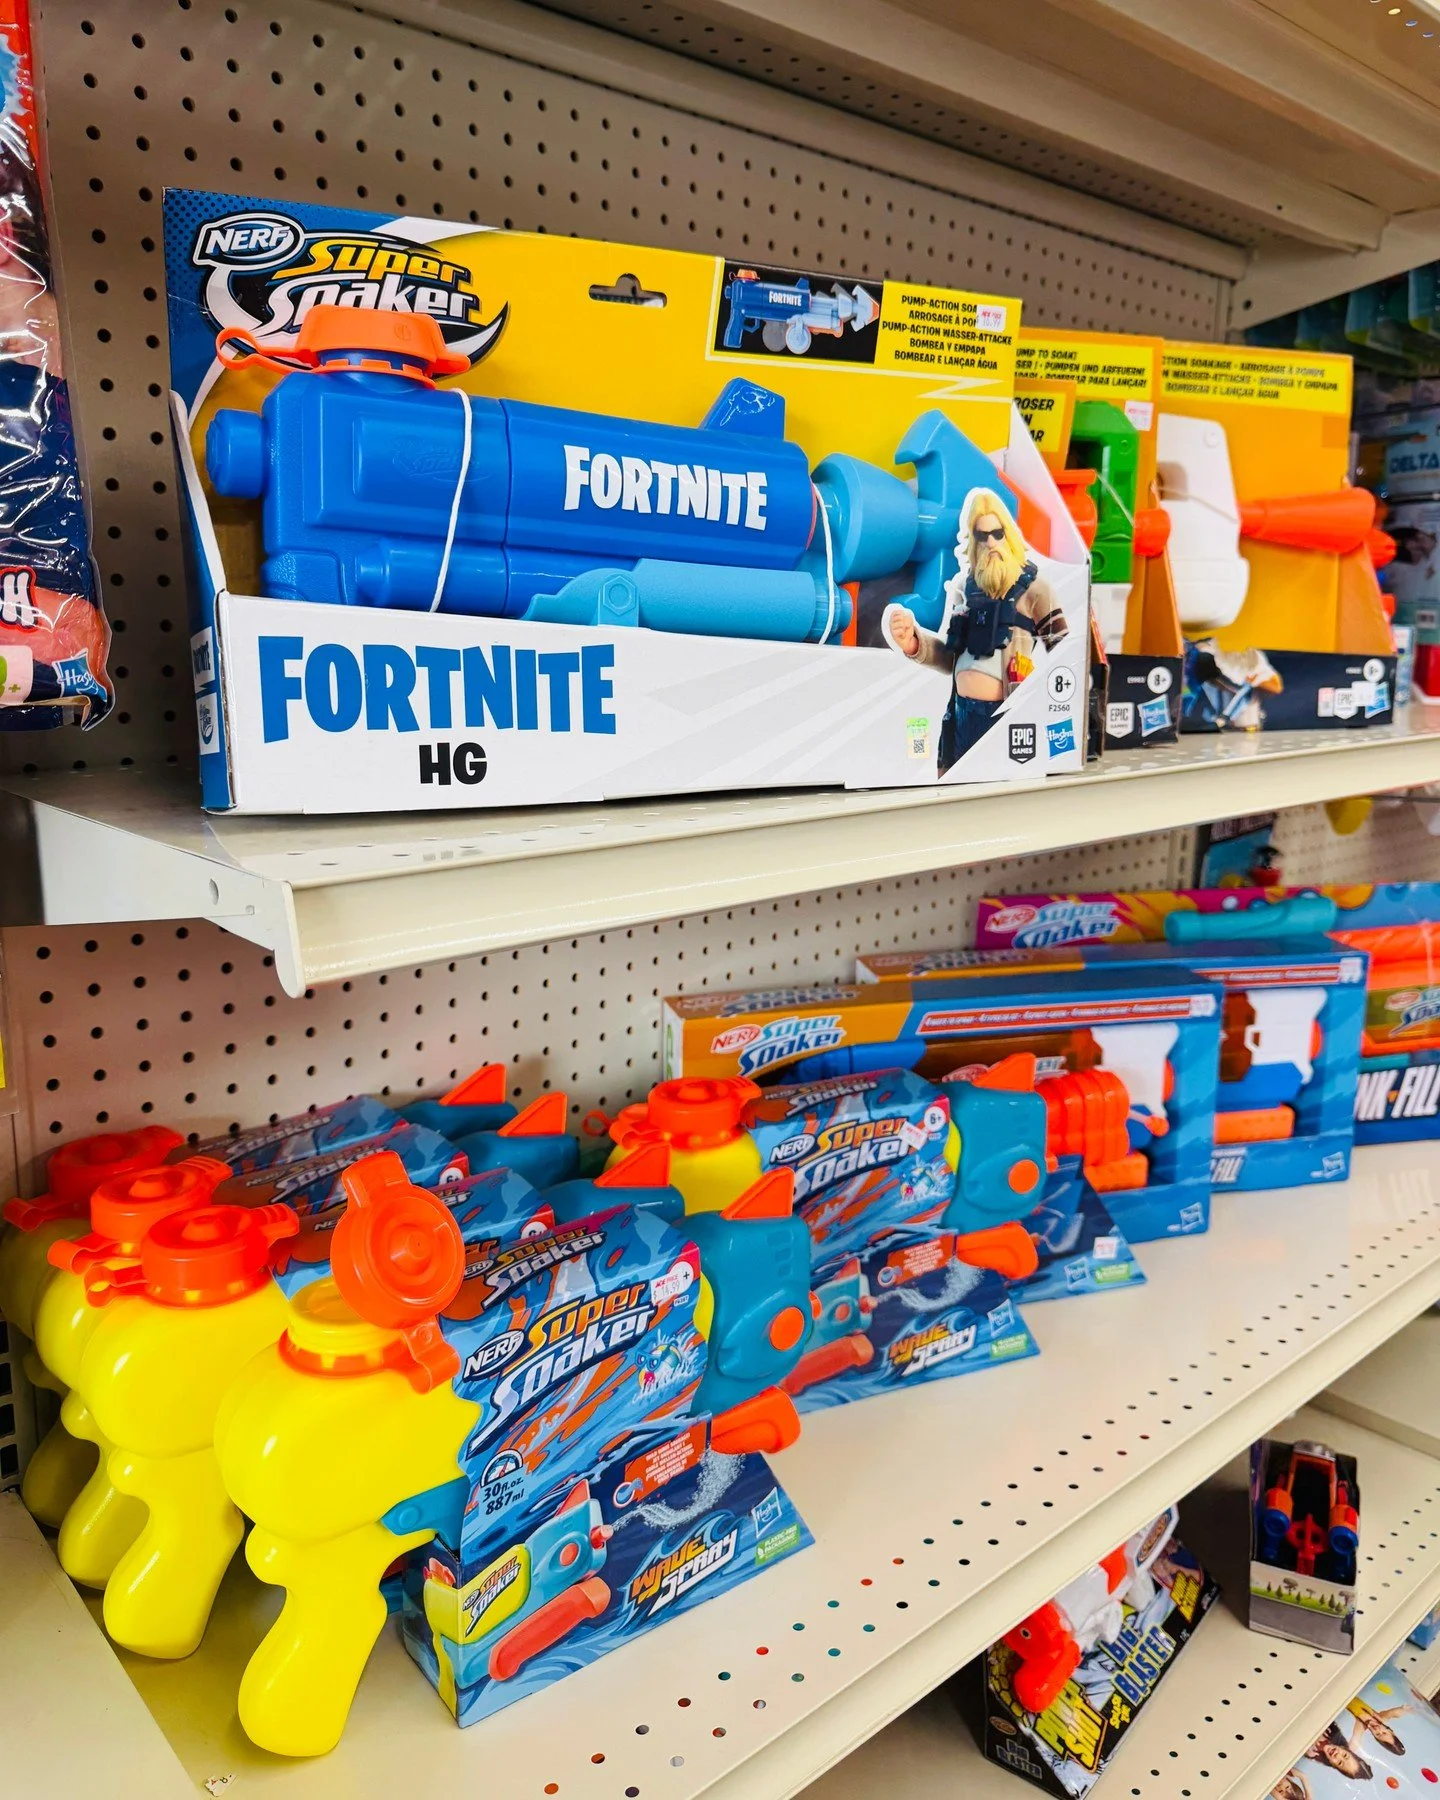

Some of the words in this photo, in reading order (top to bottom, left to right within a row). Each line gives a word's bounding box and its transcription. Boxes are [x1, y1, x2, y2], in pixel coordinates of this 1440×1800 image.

[205, 225, 291, 253] NERF
[272, 239, 465, 284] Super
[769, 290, 802, 306] FORTNITE
[901, 295, 959, 310] PUMP-ACTION
[909, 310, 952, 323] ARROSAGE
[882, 321, 940, 336] PUMP-ACTION
[942, 328, 1012, 345] WASSER-ATTACKE
[910, 338, 944, 350] BOMBEA
[947, 342, 952, 351] Y
[954, 344, 986, 355] EMPAPA
[894, 350, 935, 363] BOMBEAR
[937, 355, 942, 364] E
[944, 356, 975, 369] LANÇAR
[977, 357, 998, 370] ÁGUA
[563, 444, 767, 531] FORTNITE
[258, 636, 616, 743] FORTNITE
[1055, 675, 1072, 692] 8+
[1110, 708, 1128, 721] EPIC
[1012, 729, 1033, 746] EPIC
[418, 742, 488, 785] HG
[760, 1016, 842, 1041] Super
[739, 1030, 843, 1077] Soaker
[464, 1259, 494, 1276] ERF
[484, 1231, 607, 1308] Soaker
[490, 1227, 588, 1274] Super
[502, 1284, 645, 1377] Super
[901, 1325, 977, 1377] SPRAY
[464, 1330, 523, 1379] NERF
[631, 1535, 707, 1605] WAVE
[648, 1531, 738, 1616] SPRAY
[1111, 1623, 1177, 1707] BLASTER
[1063, 1696, 1104, 1769] SHOT
